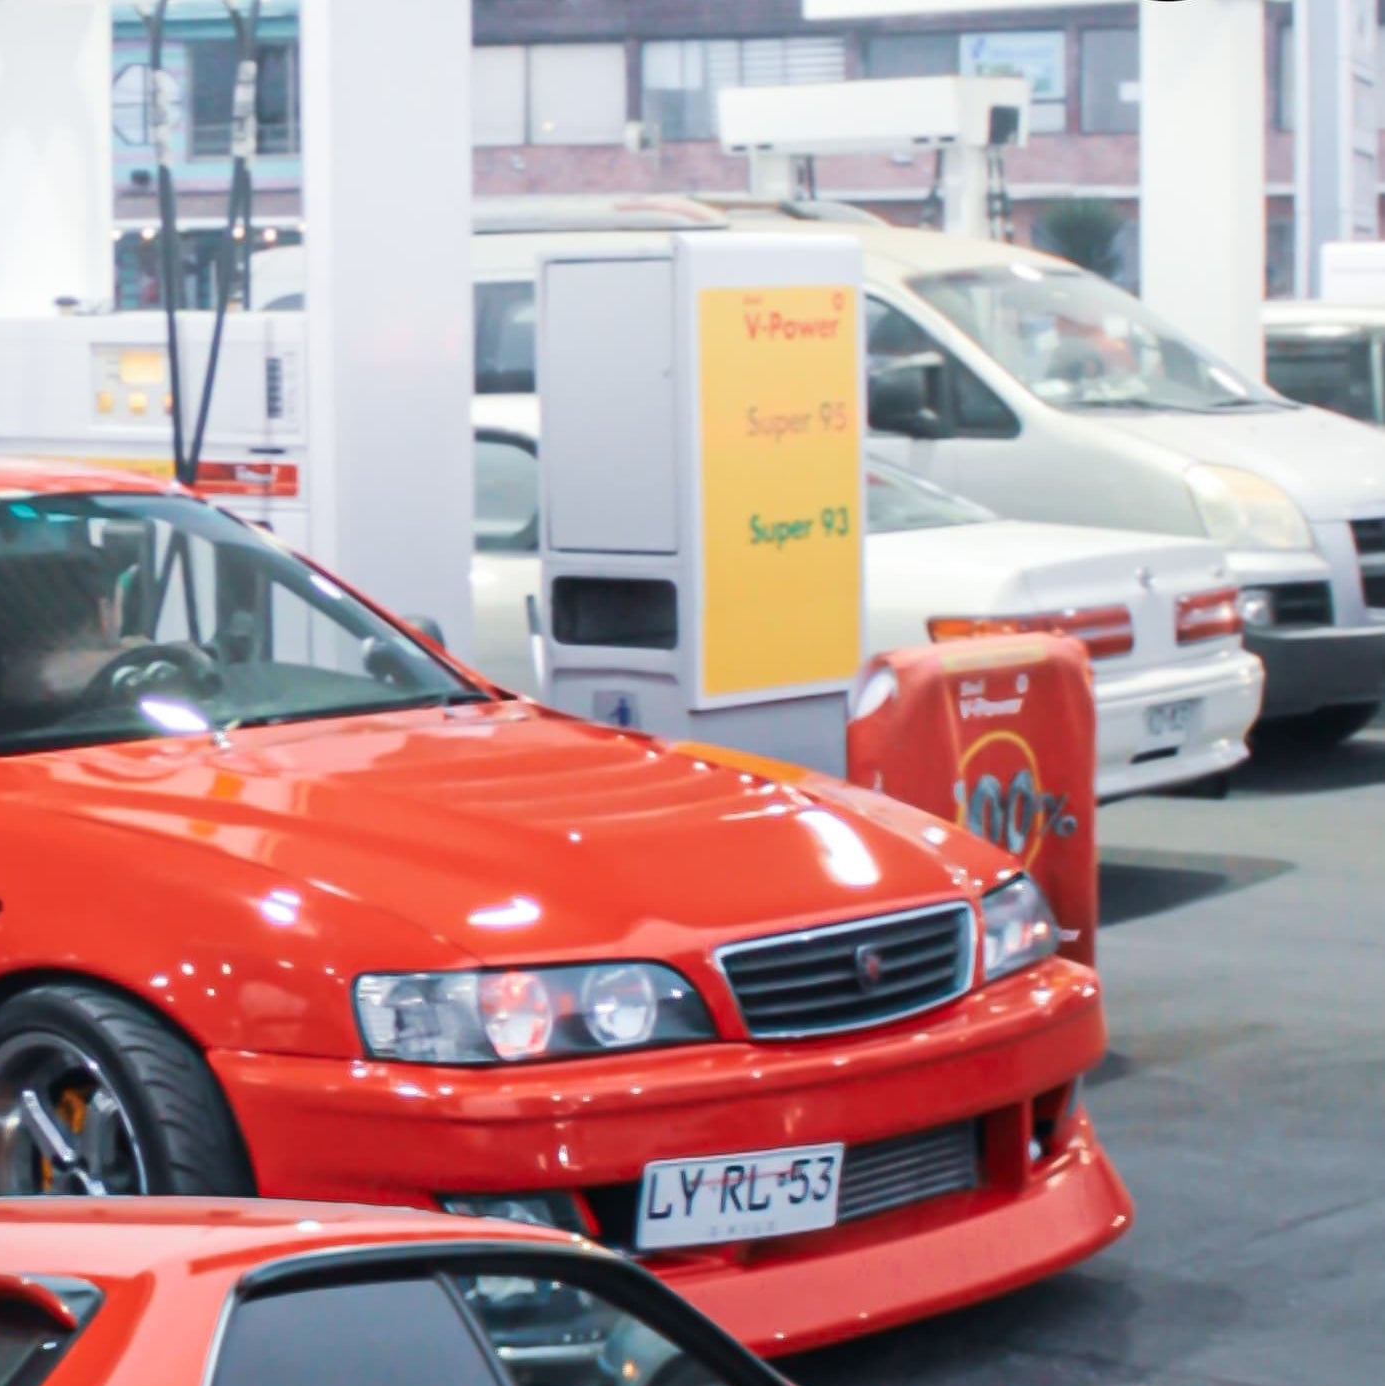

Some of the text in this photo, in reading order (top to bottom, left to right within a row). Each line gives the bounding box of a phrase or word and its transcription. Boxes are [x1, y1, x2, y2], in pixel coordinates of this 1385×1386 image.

[744, 311, 840, 340] V-Power
[747, 401, 847, 443] Super 95
[749, 505, 850, 551] Super 93
